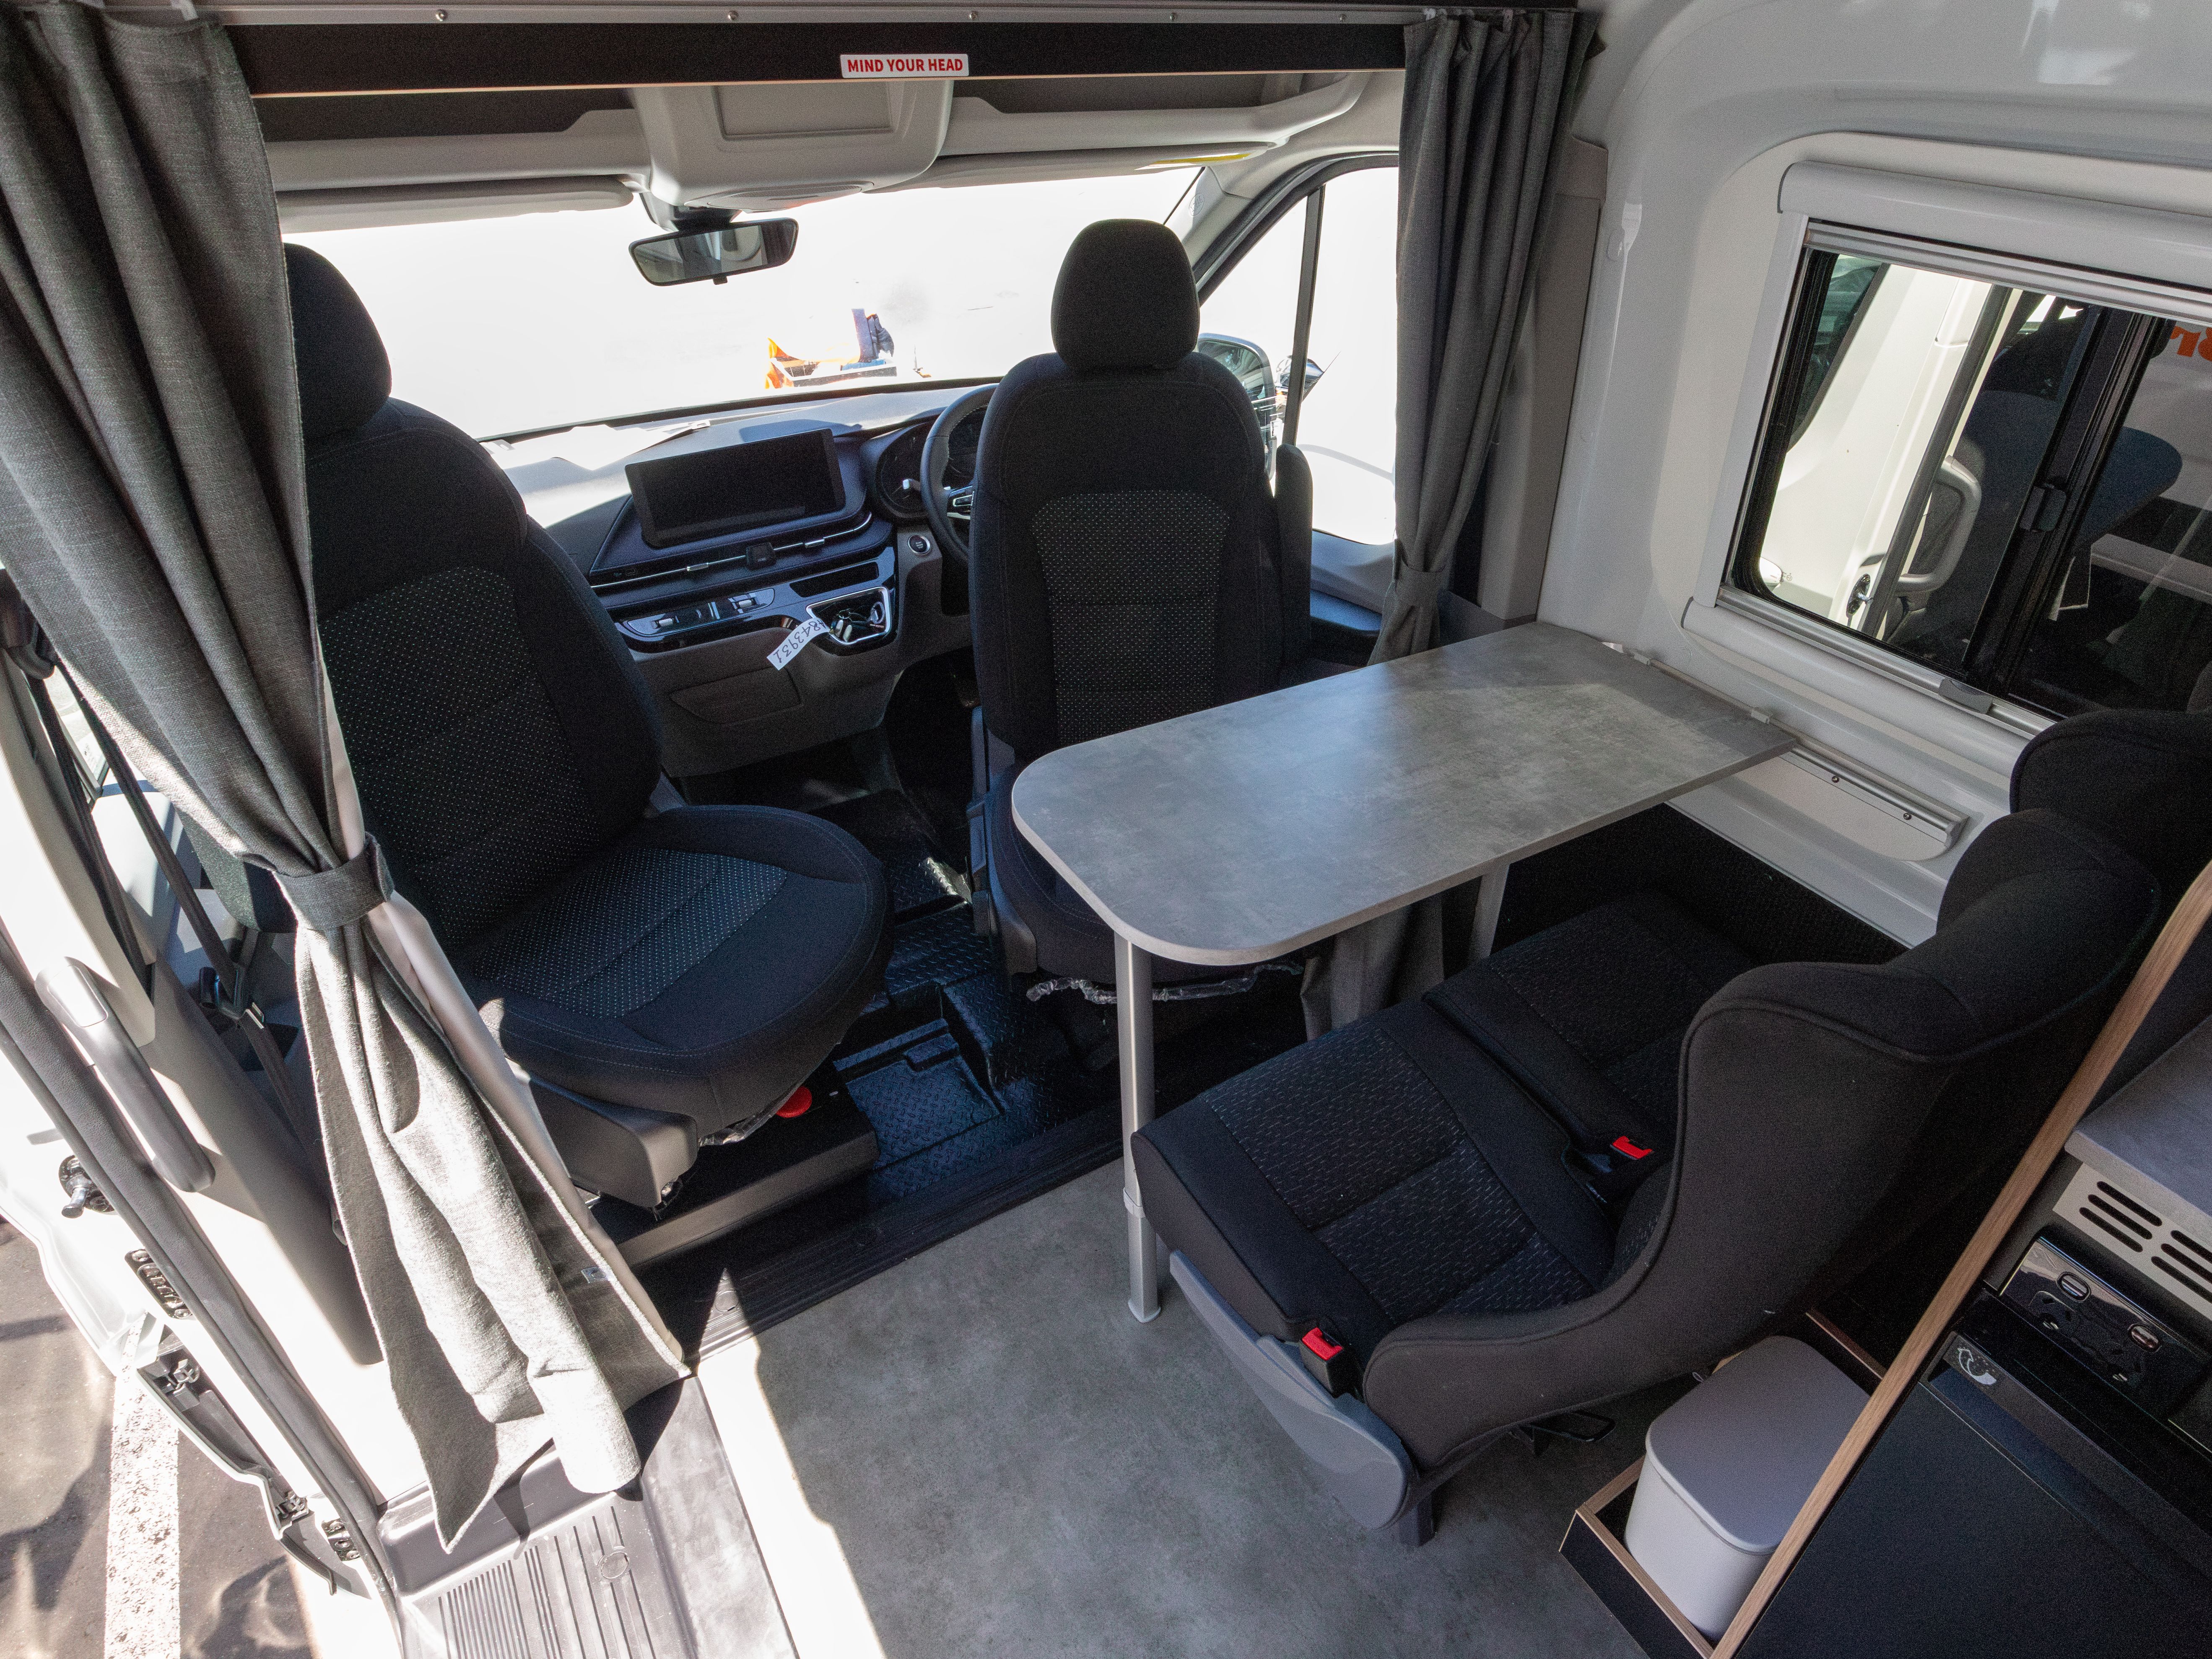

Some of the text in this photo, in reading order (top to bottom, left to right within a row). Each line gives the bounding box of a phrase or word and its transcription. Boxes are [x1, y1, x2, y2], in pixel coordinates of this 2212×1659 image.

[847, 58, 963, 72] MIND YOUR HEAD
